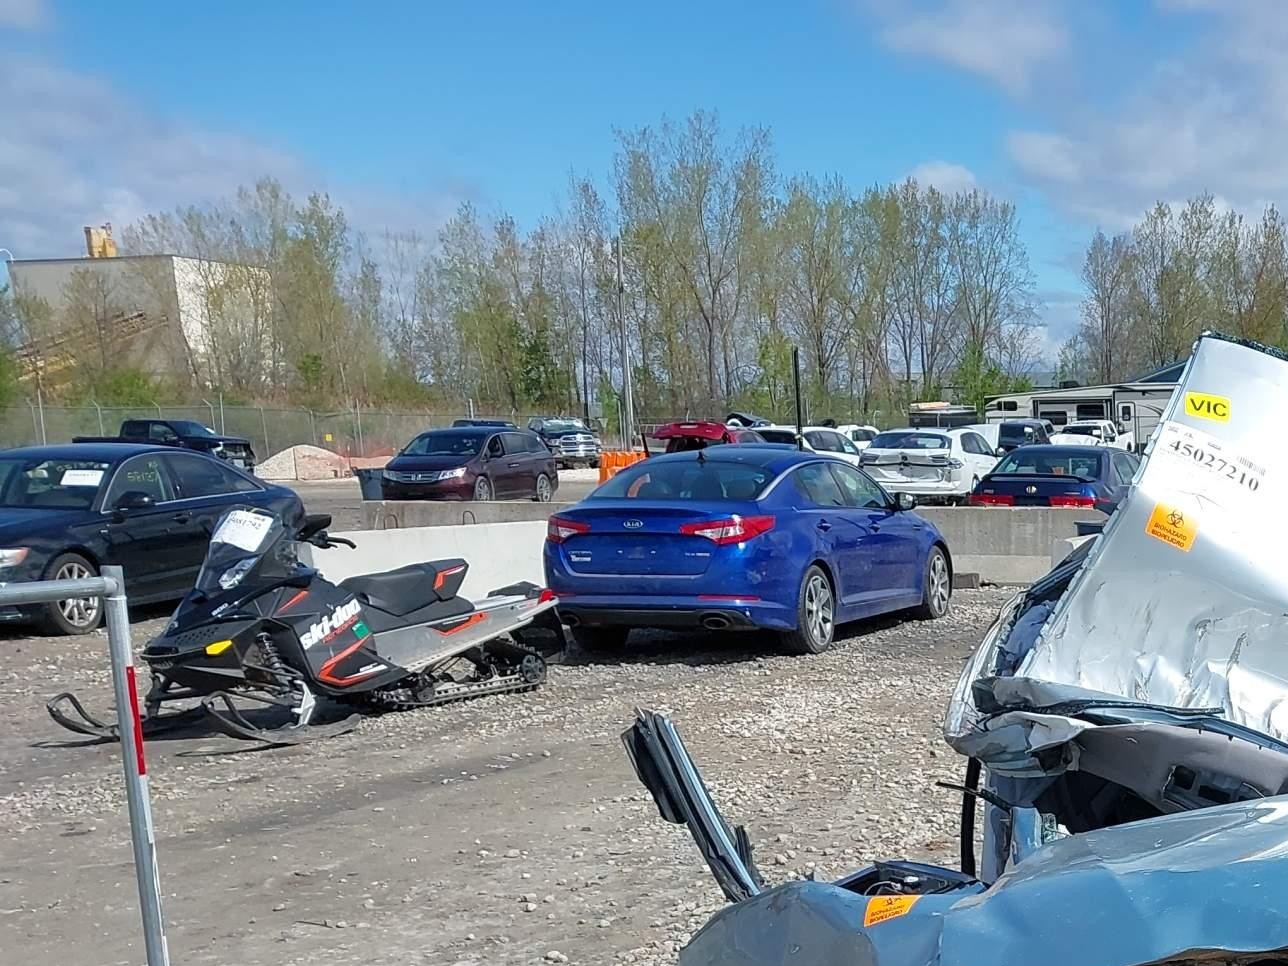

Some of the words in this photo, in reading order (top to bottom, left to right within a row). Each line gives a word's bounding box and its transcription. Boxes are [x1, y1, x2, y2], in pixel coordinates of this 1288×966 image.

[1190, 398, 1227, 417] VIC
[1169, 440, 1259, 491] 45027210
[1151, 529, 1185, 547] BIOPELIGRO
[1154, 522, 1187, 541] BIOHAZARD
